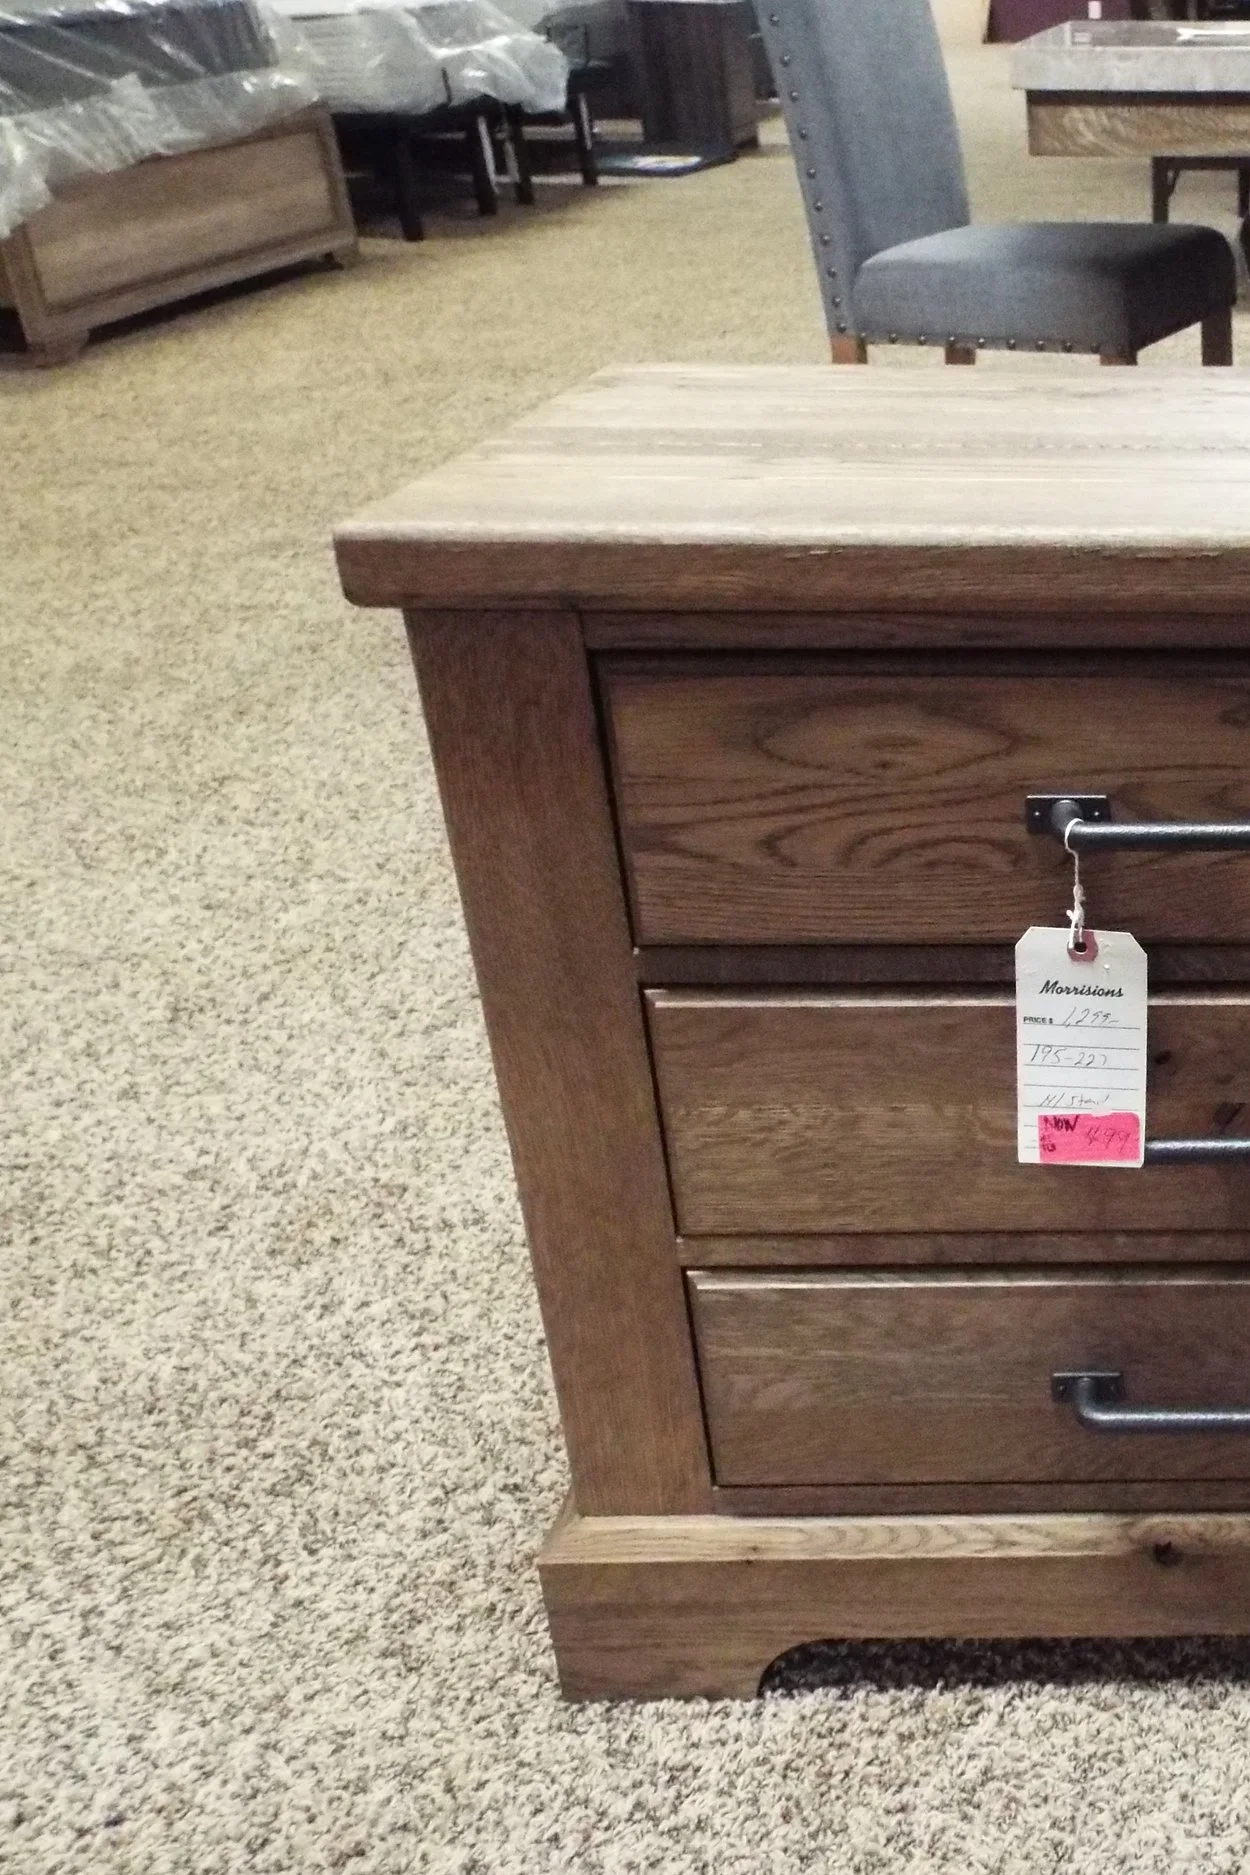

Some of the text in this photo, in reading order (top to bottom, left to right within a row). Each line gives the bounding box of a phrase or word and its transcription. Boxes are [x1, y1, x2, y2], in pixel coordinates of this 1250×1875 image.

[1039, 979, 1124, 997] Morrisions
[1023, 1015, 1047, 1025] PRICE
[1042, 1113, 1080, 1133] NOW
